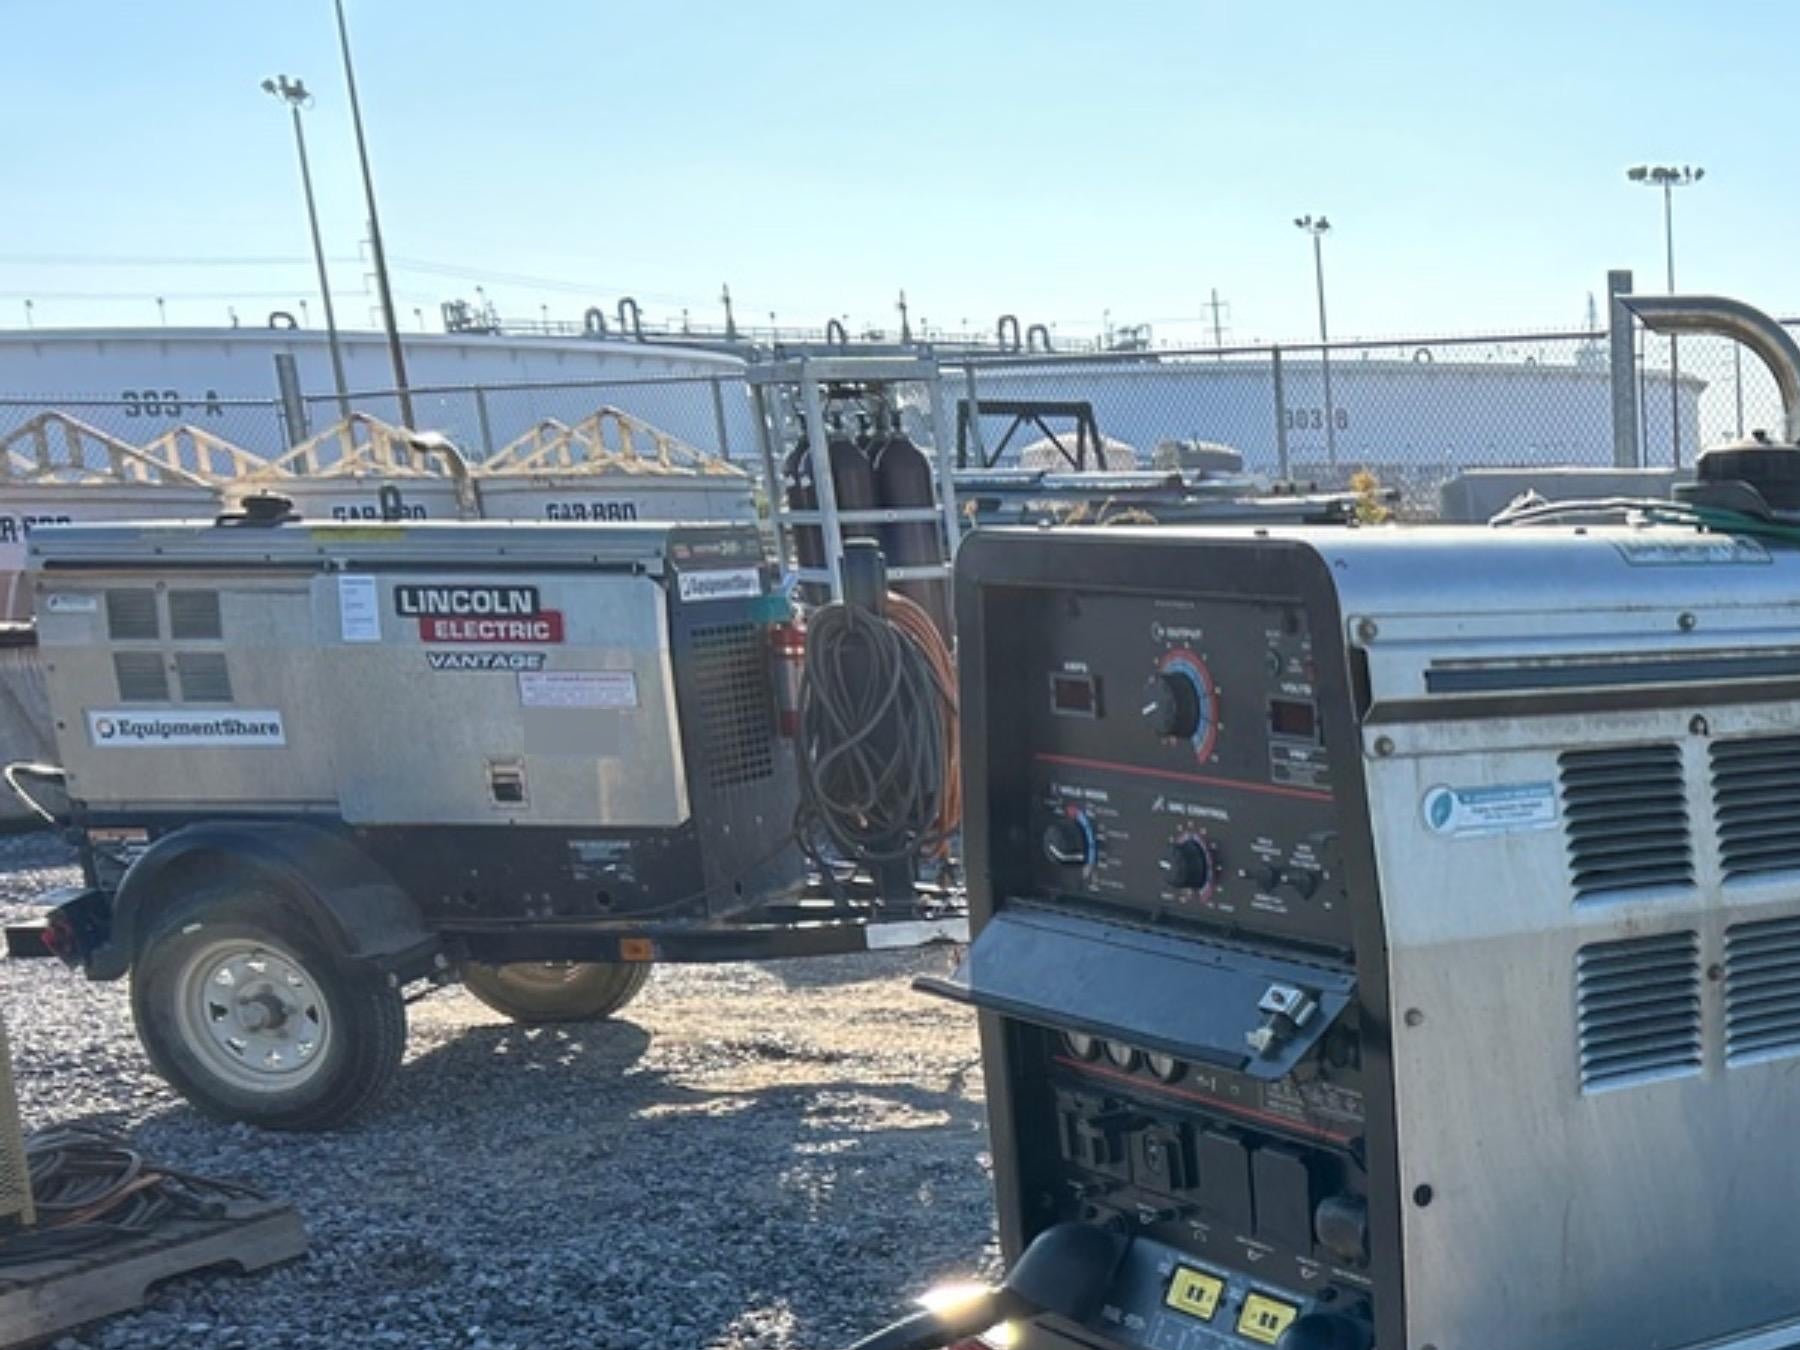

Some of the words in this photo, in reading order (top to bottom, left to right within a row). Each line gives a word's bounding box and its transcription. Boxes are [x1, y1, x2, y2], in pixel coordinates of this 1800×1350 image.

[401, 590, 533, 614] LINCOLN
[434, 620, 550, 640] ELECTRIC
[428, 653, 541, 668] VANTAGE
[117, 718, 279, 738] EquipmentShare
